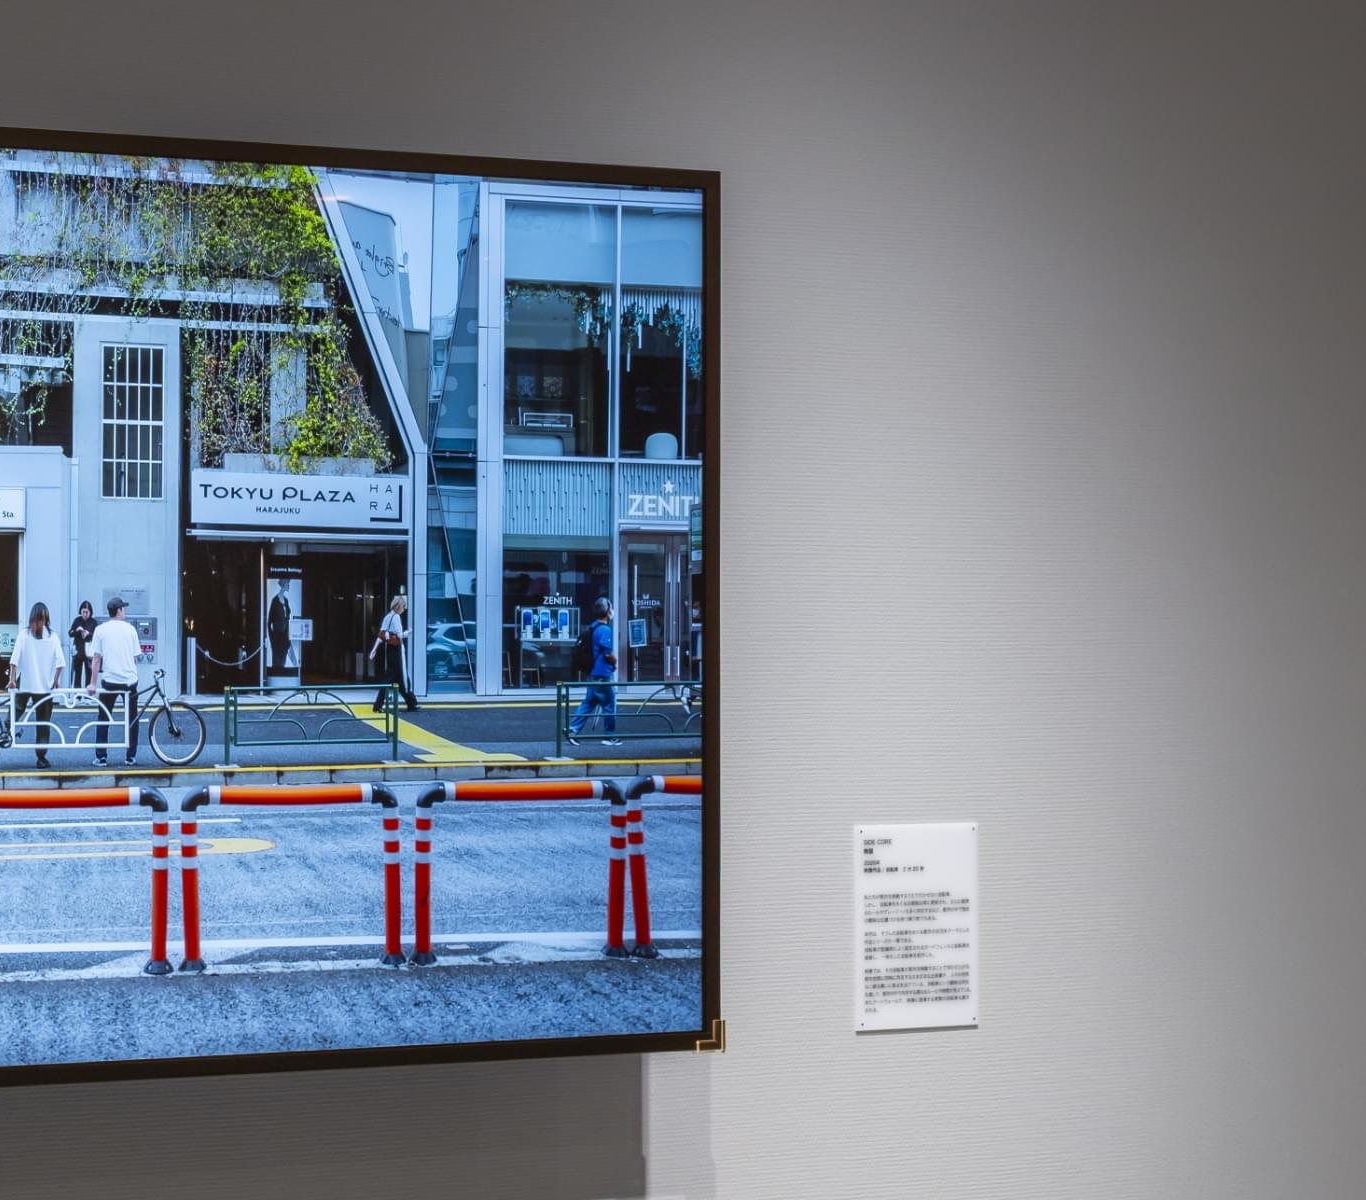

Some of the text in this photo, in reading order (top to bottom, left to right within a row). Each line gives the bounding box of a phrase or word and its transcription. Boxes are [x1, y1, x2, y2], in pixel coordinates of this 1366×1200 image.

[199, 484, 356, 503] TOKYU PLAZA
[256, 506, 301, 515] HARAJUKU
[628, 494, 699, 517] ZENIT
[543, 597, 573, 605] ZENITH
